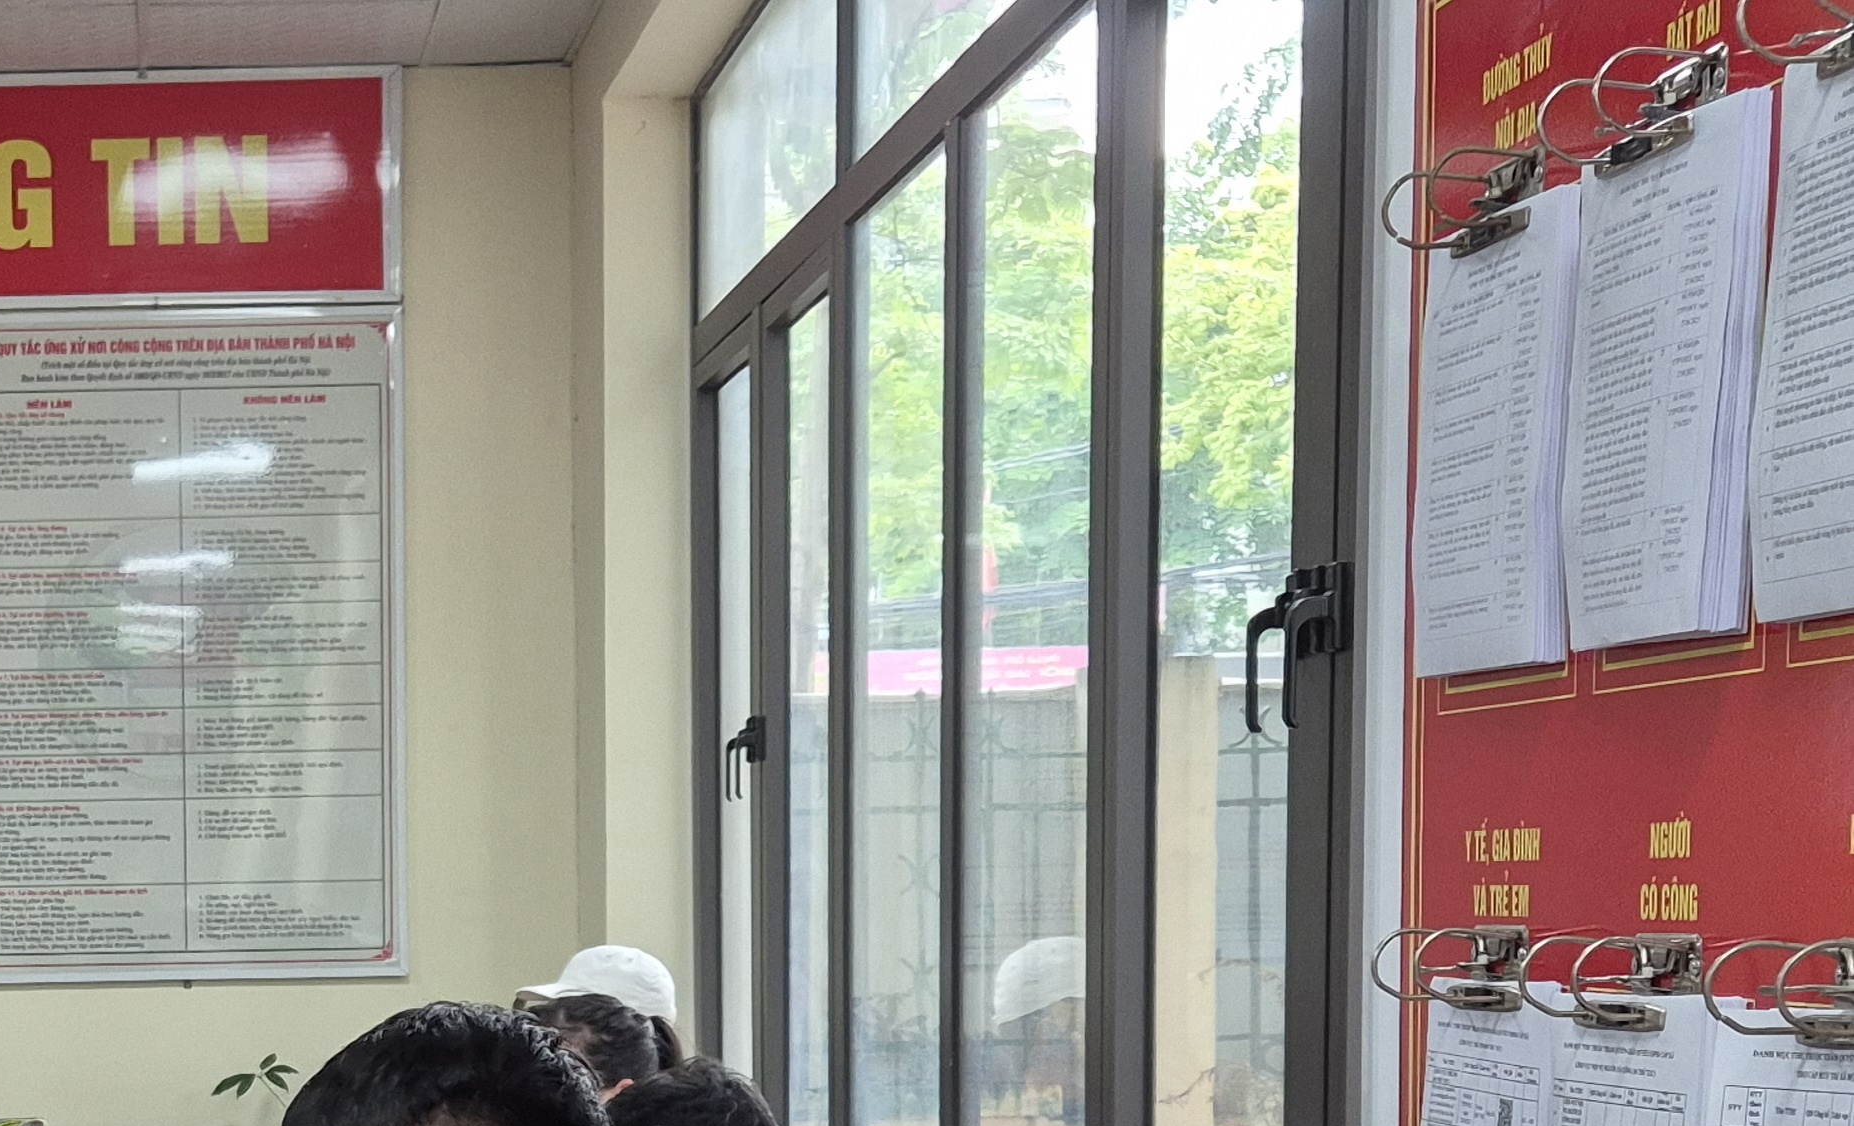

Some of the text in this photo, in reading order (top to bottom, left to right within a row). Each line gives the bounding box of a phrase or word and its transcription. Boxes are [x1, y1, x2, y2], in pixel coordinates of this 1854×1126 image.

[91, 135, 270, 247] TIN
[1465, 831, 1473, 863] Y
[1492, 828, 1510, 862] GIA
[1513, 820, 1541, 862] ĐÌNH
[1649, 811, 1692, 859] NGƯỜI
[1473, 870, 1530, 917] VÀ TRẺ EM
[1640, 876, 1698, 922] CÓ CÔNG
